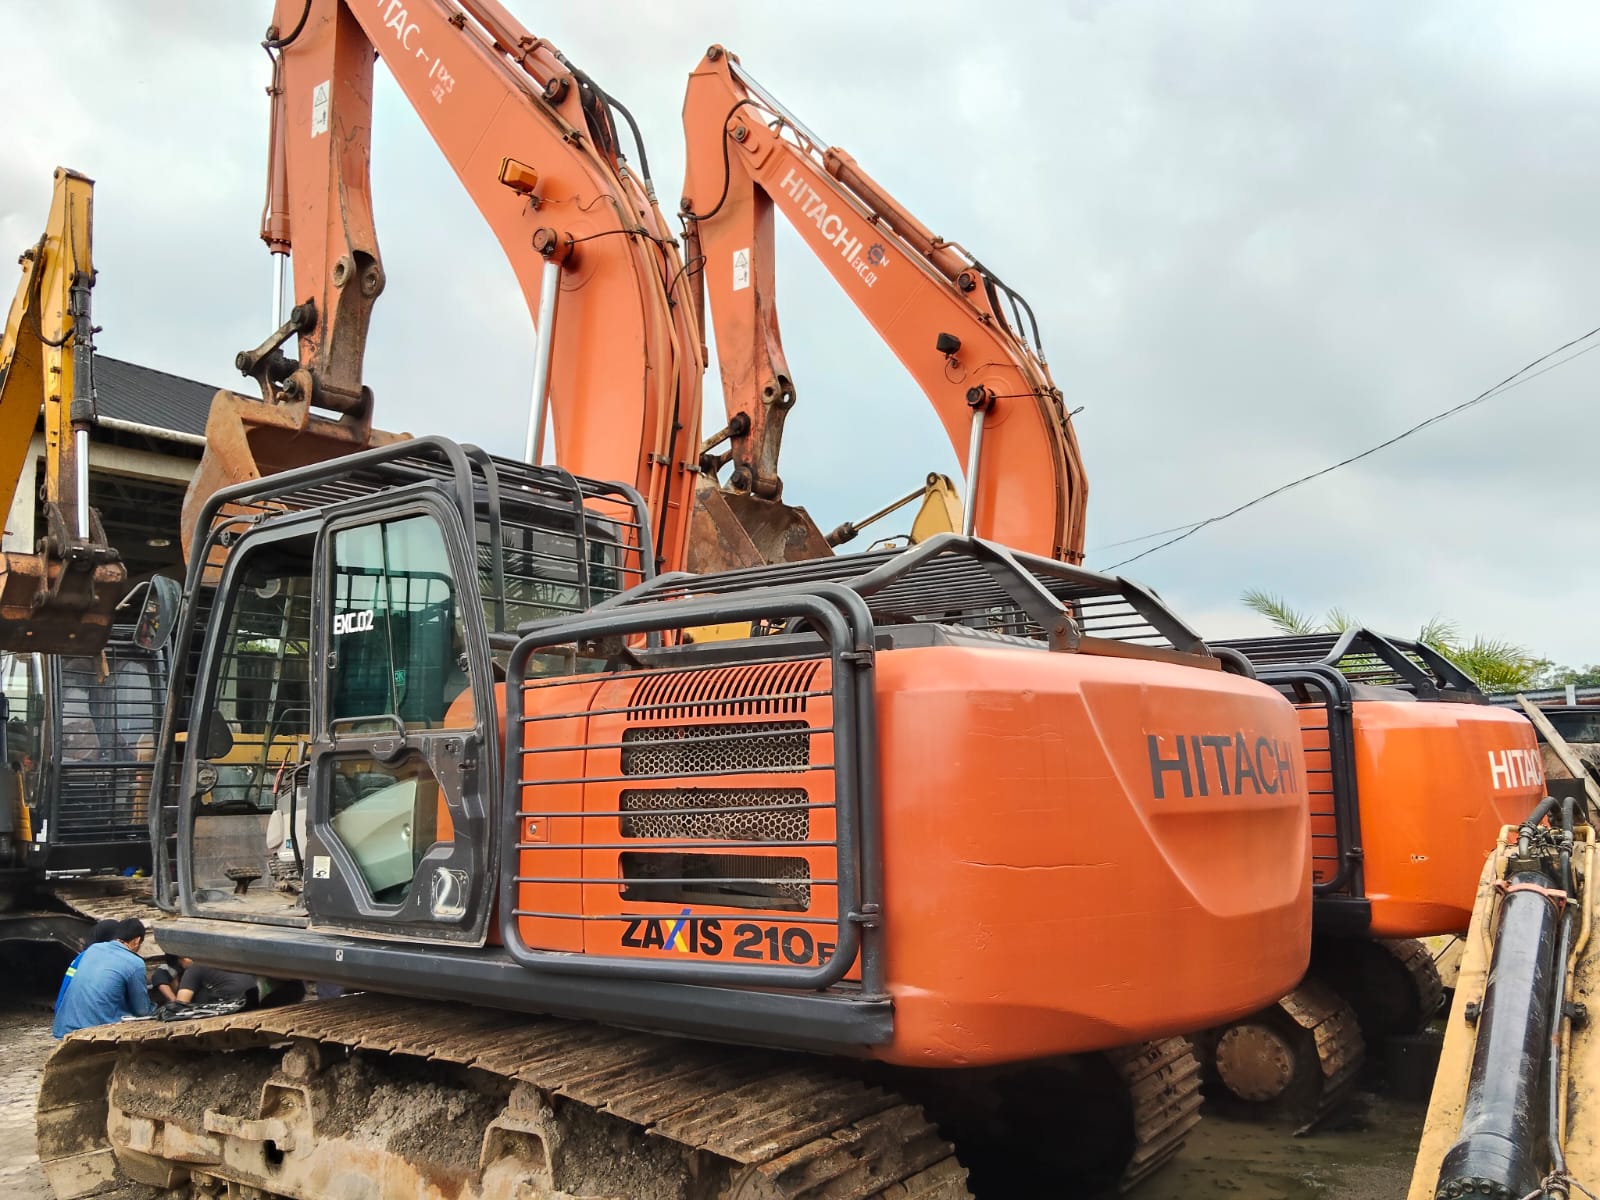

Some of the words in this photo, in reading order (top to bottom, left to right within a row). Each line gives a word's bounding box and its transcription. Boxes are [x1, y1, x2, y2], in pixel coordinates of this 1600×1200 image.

[377, 0, 440, 78] TACI
[781, 169, 863, 262] HITACHI
[333, 609, 374, 635] EXC.02
[1147, 731, 1298, 799] HITACHI
[621, 908, 723, 956] ZAXIS
